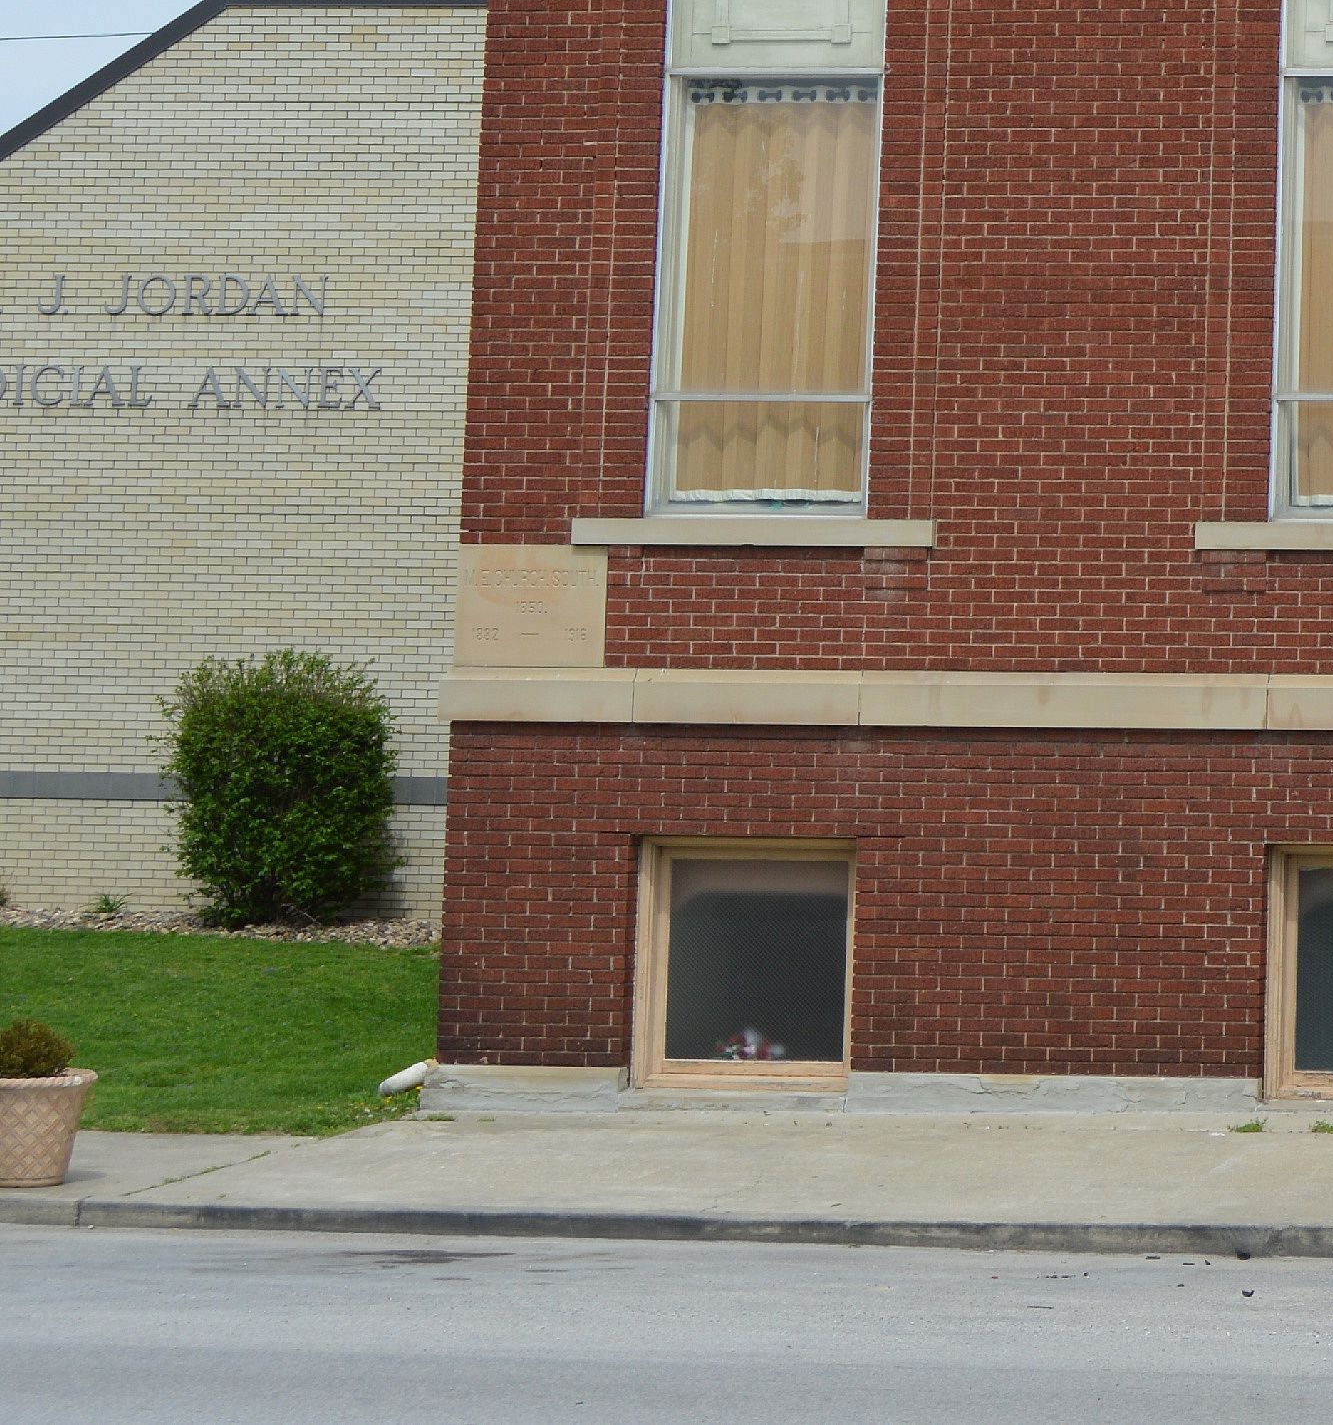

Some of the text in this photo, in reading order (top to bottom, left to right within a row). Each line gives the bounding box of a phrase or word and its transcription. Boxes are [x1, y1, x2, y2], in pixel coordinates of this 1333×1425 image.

[38, 273, 329, 318] J. JORDAN
[0, 364, 382, 411] ICIAL ANNEX
